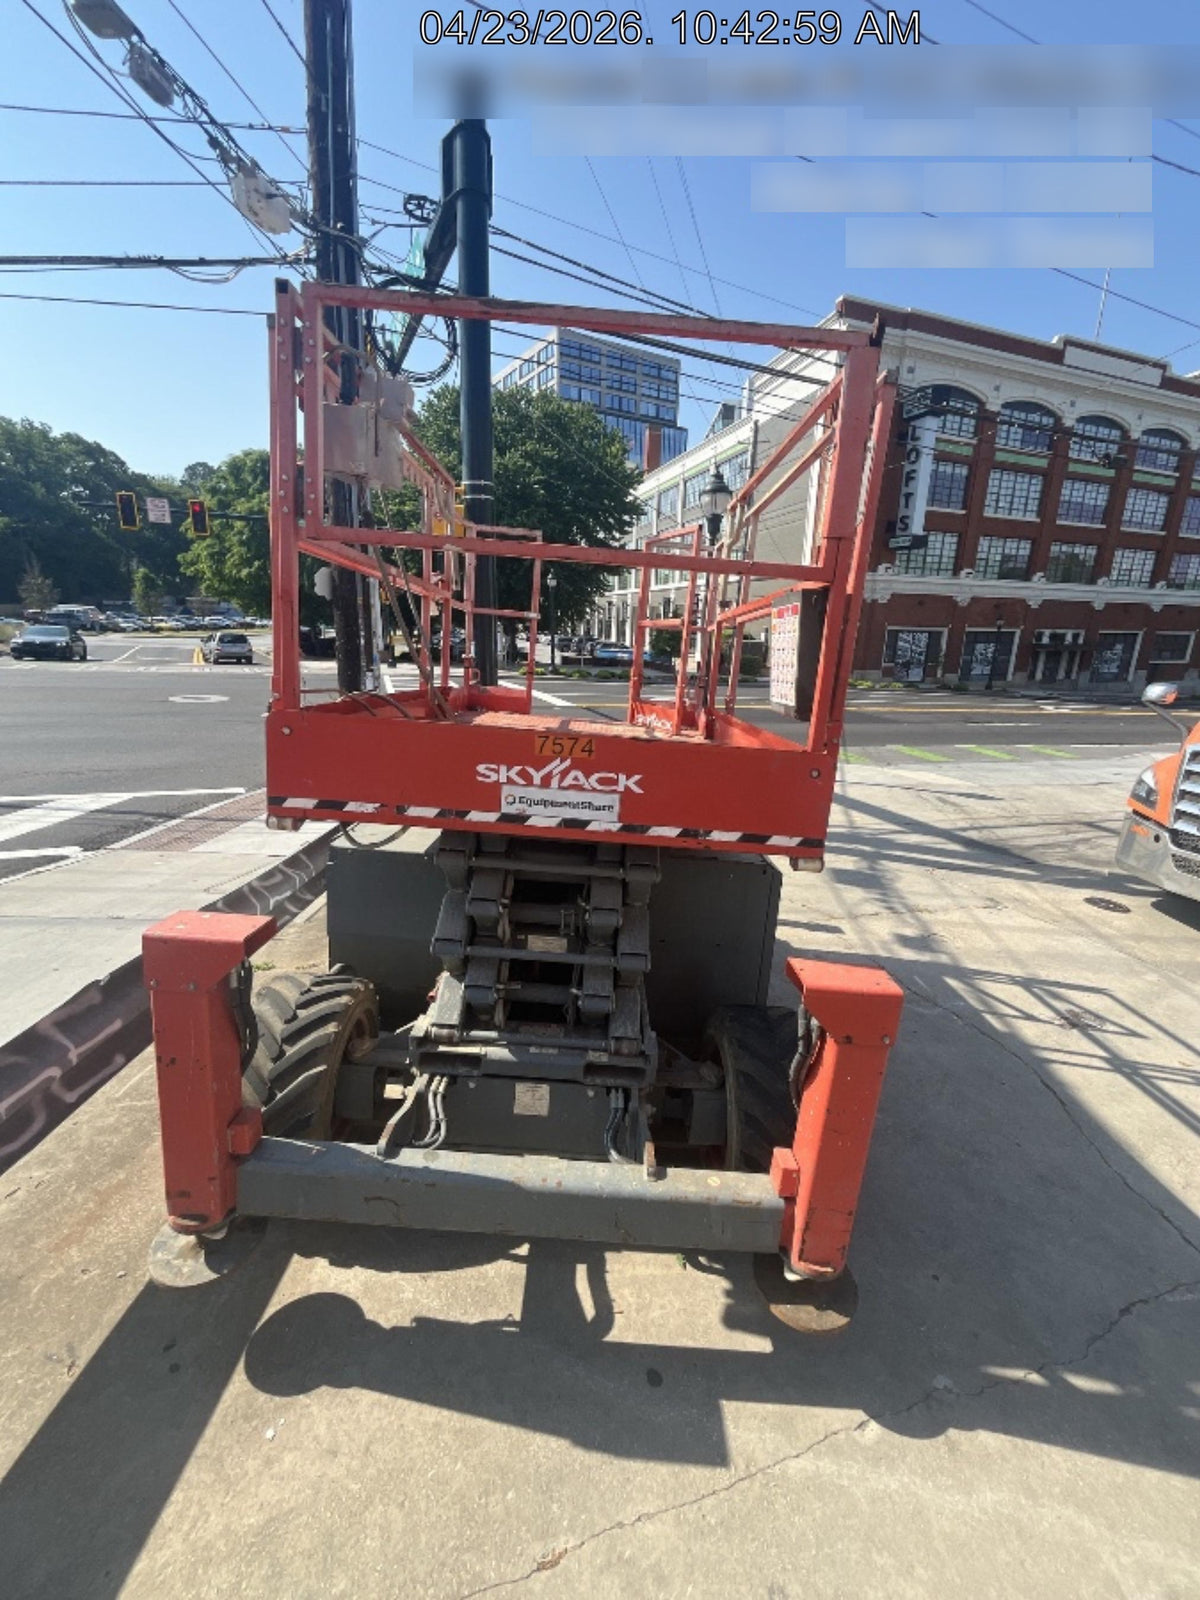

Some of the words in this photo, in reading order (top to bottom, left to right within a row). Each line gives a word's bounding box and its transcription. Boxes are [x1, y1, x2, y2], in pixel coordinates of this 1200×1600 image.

[898, 425, 920, 532] LOFTS
[538, 736, 594, 756] 7574
[475, 757, 644, 793] SKYJACK
